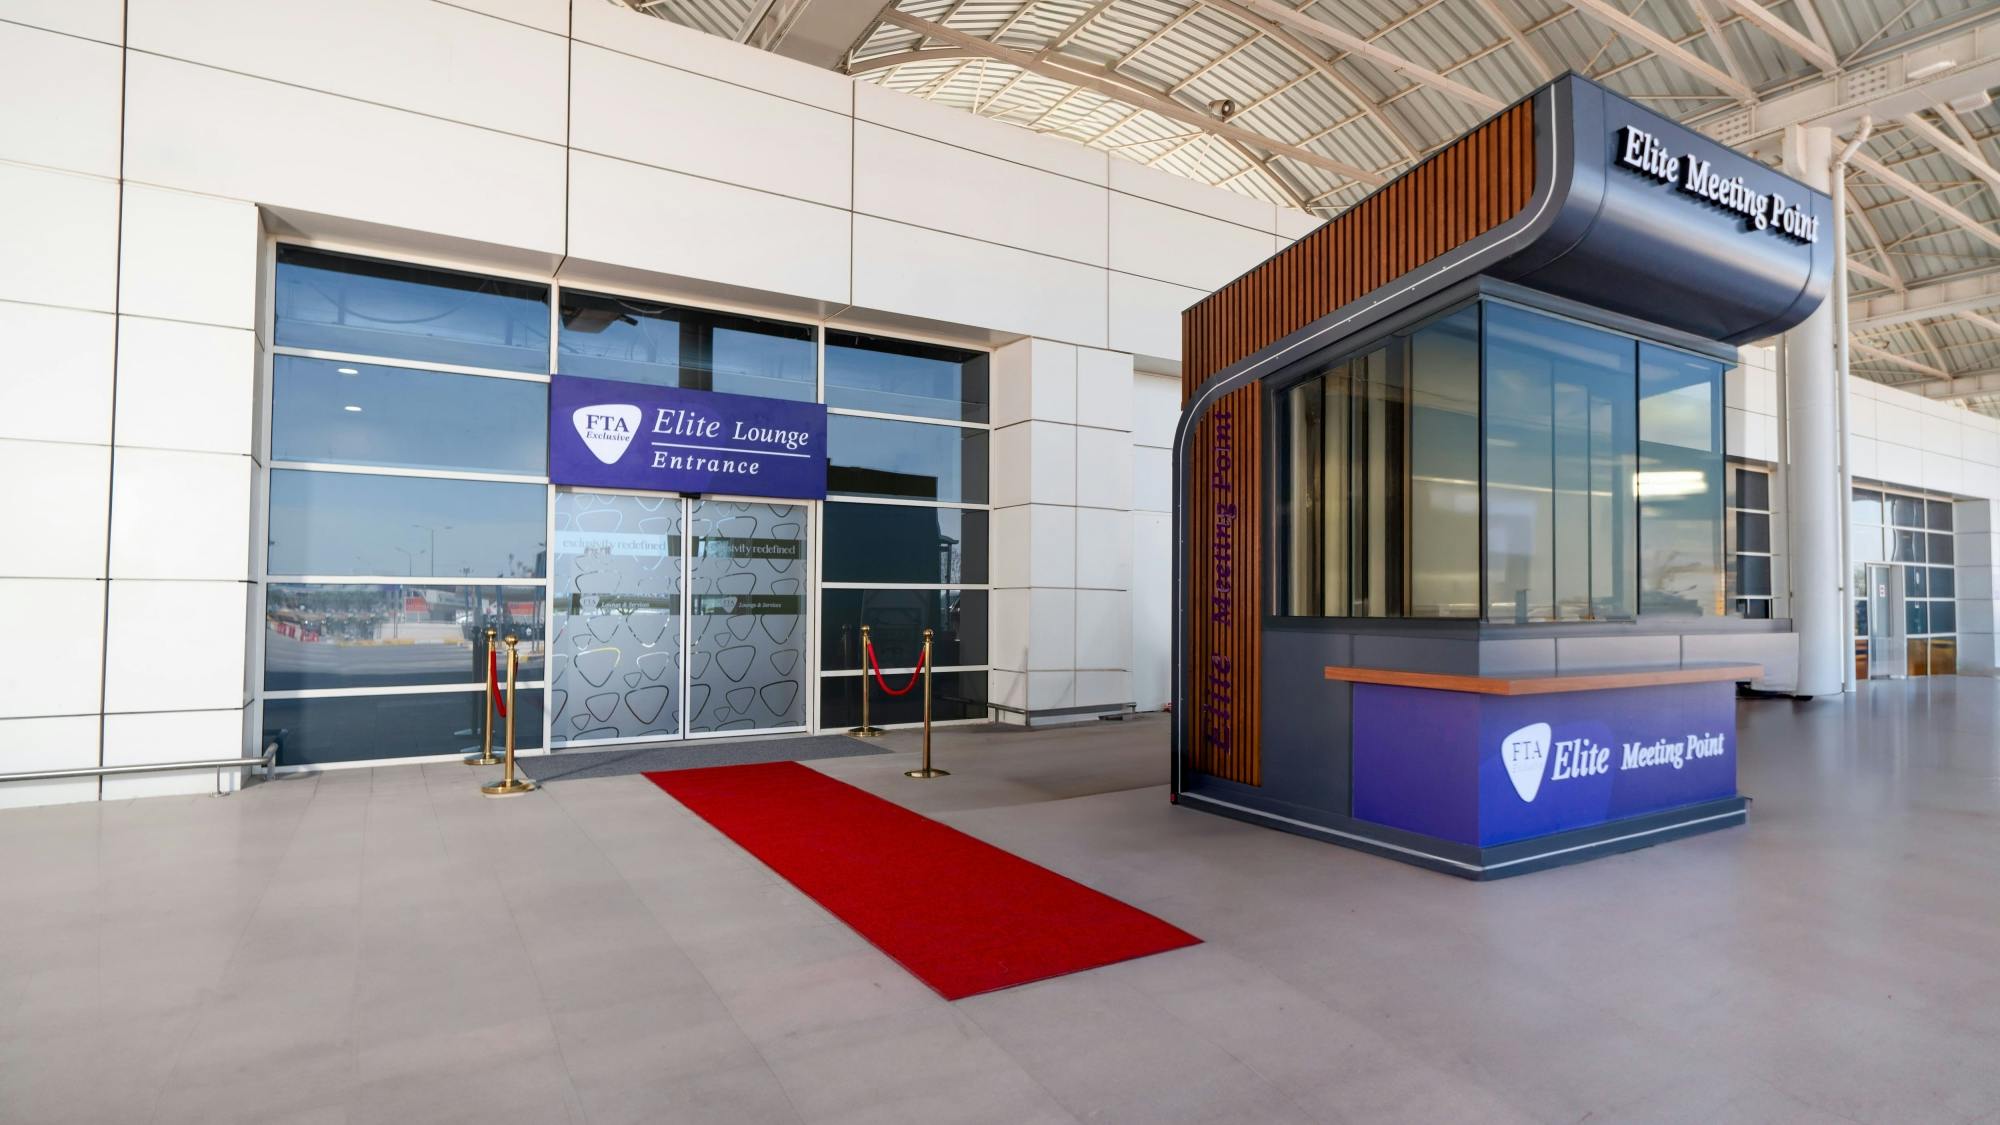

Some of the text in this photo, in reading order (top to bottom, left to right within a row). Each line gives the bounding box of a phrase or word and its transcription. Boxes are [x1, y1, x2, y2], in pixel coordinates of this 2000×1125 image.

[1623, 124, 1820, 243] Elite Meeting Point
[586, 414, 629, 432] FTA
[651, 407, 809, 450] Elite Lounge
[586, 431, 630, 441] Exclusive
[651, 451, 760, 475] Entrance
[752, 544, 796, 554] redefined
[1202, 411, 1238, 755] Elite Meeting Point
[1512, 740, 1542, 761] FTA
[1552, 732, 1725, 781] Elite Meeting Point
